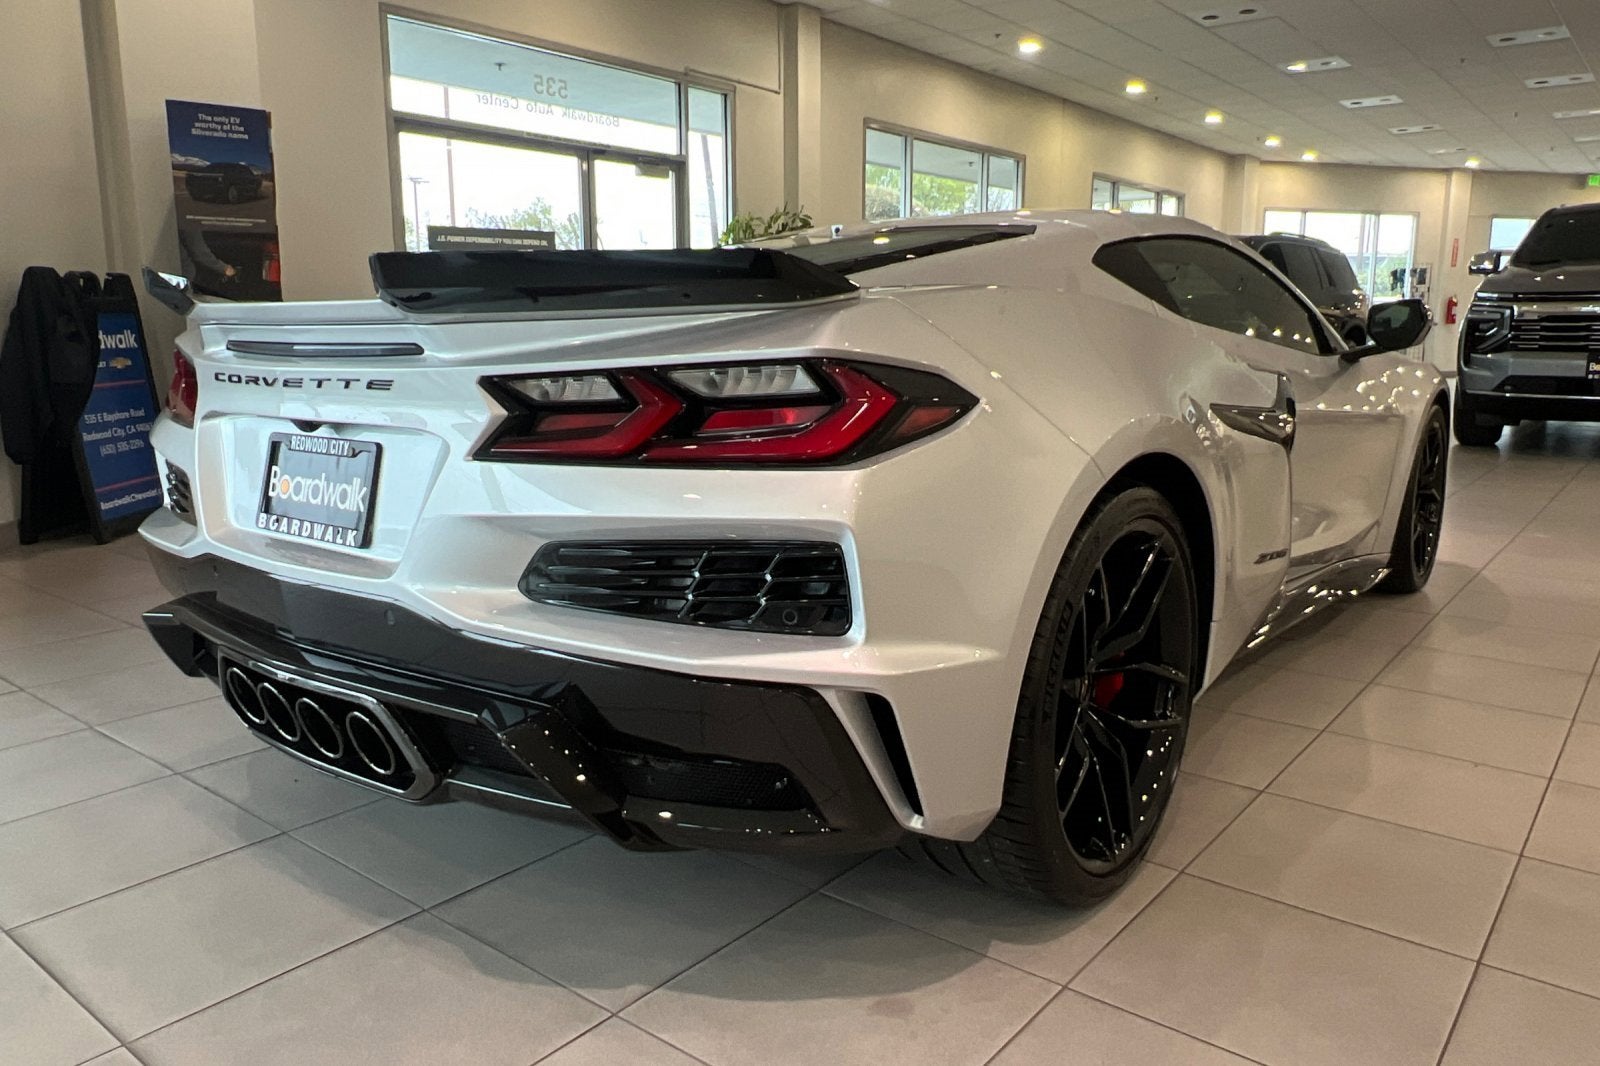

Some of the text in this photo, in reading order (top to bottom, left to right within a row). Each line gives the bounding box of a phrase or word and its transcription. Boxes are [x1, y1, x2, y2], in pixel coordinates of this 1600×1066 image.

[230, 116, 241, 124] EV
[214, 372, 395, 391] CORVETTE
[97, 413, 103, 422] E
[126, 424, 136, 434] CA
[291, 435, 351, 456] REDWOOD CITY
[268, 465, 368, 513] Boardwalk
[257, 512, 358, 547] BOARDWALK
